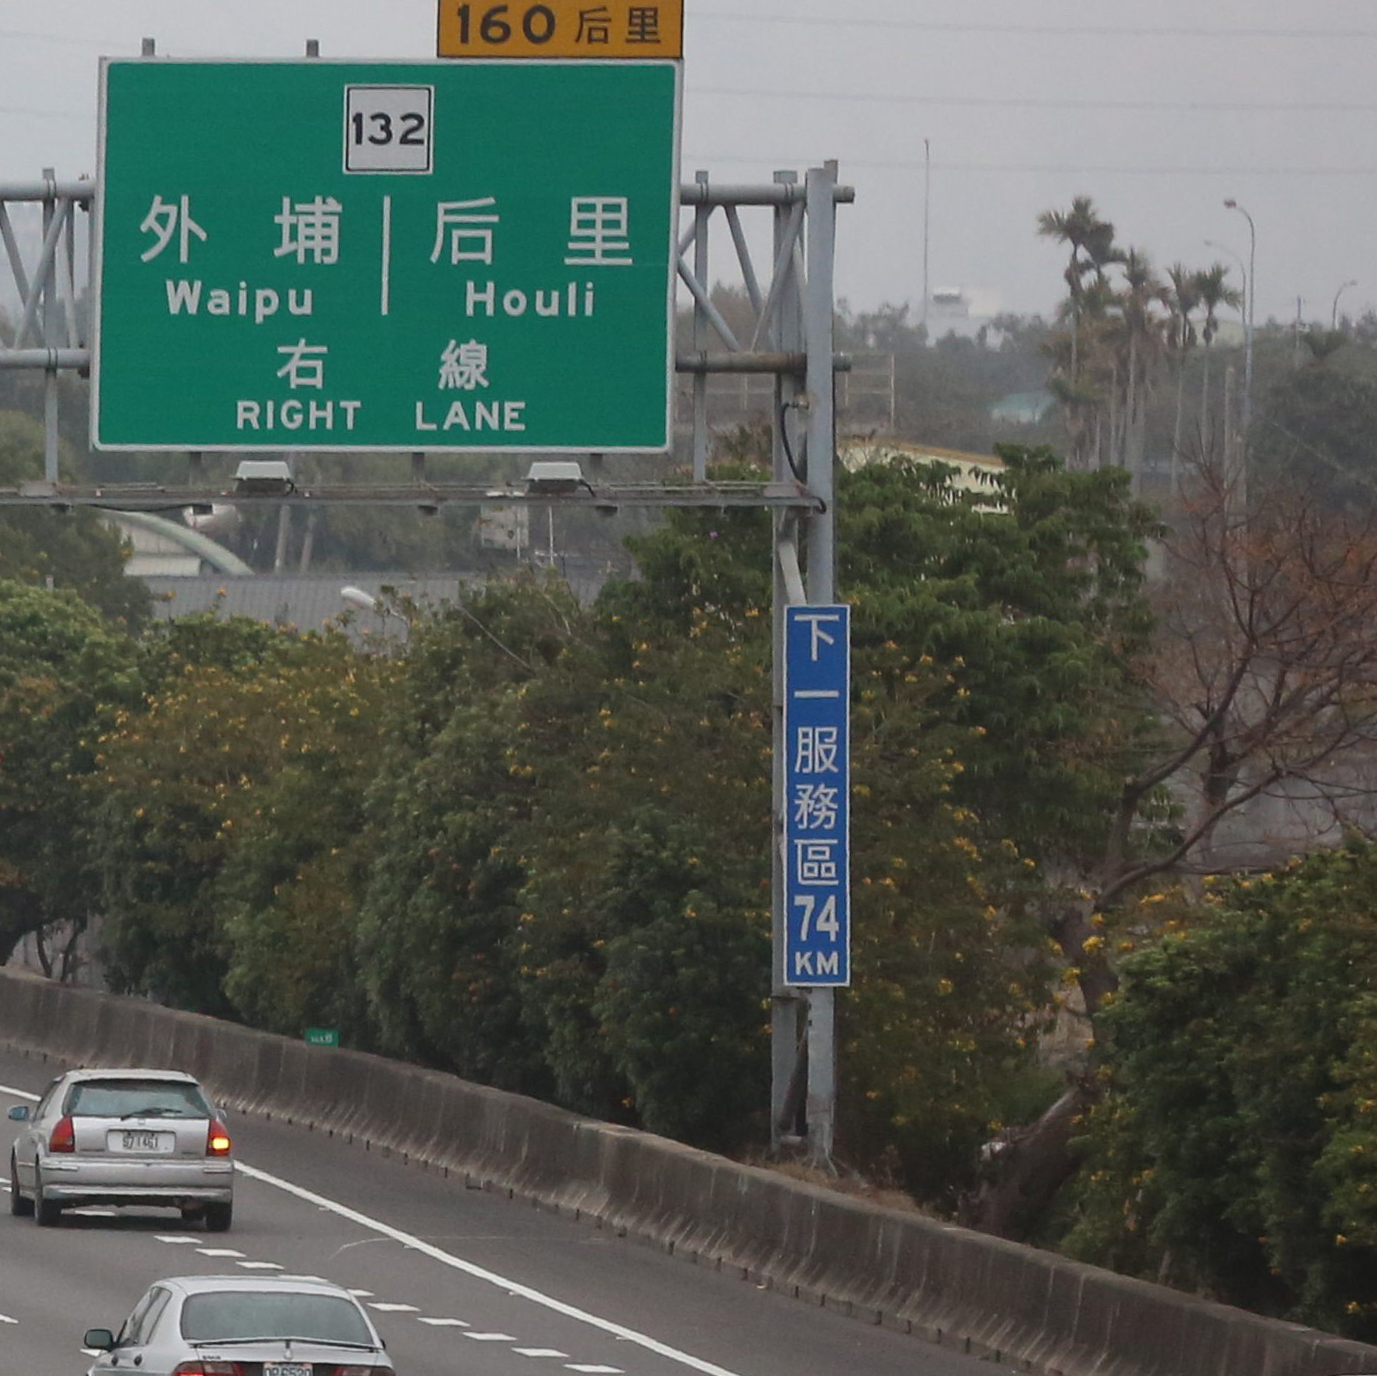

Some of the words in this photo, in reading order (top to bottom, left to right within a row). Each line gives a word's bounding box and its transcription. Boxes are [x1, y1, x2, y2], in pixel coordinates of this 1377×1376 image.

[457, 4, 556, 45] 160
[575, 6, 661, 45] 后里
[350, 111, 427, 148] 132
[139, 193, 344, 264] 外埔
[430, 195, 633, 266] 后里
[165, 279, 313, 324] Waipu
[466, 279, 595, 317] Houli
[236, 399, 362, 430] RIGHT
[415, 400, 526, 431] LANE
[793, 614, 840, 886] 下一服務區
[793, 894, 840, 942] 74
[794, 950, 839, 976] KM
